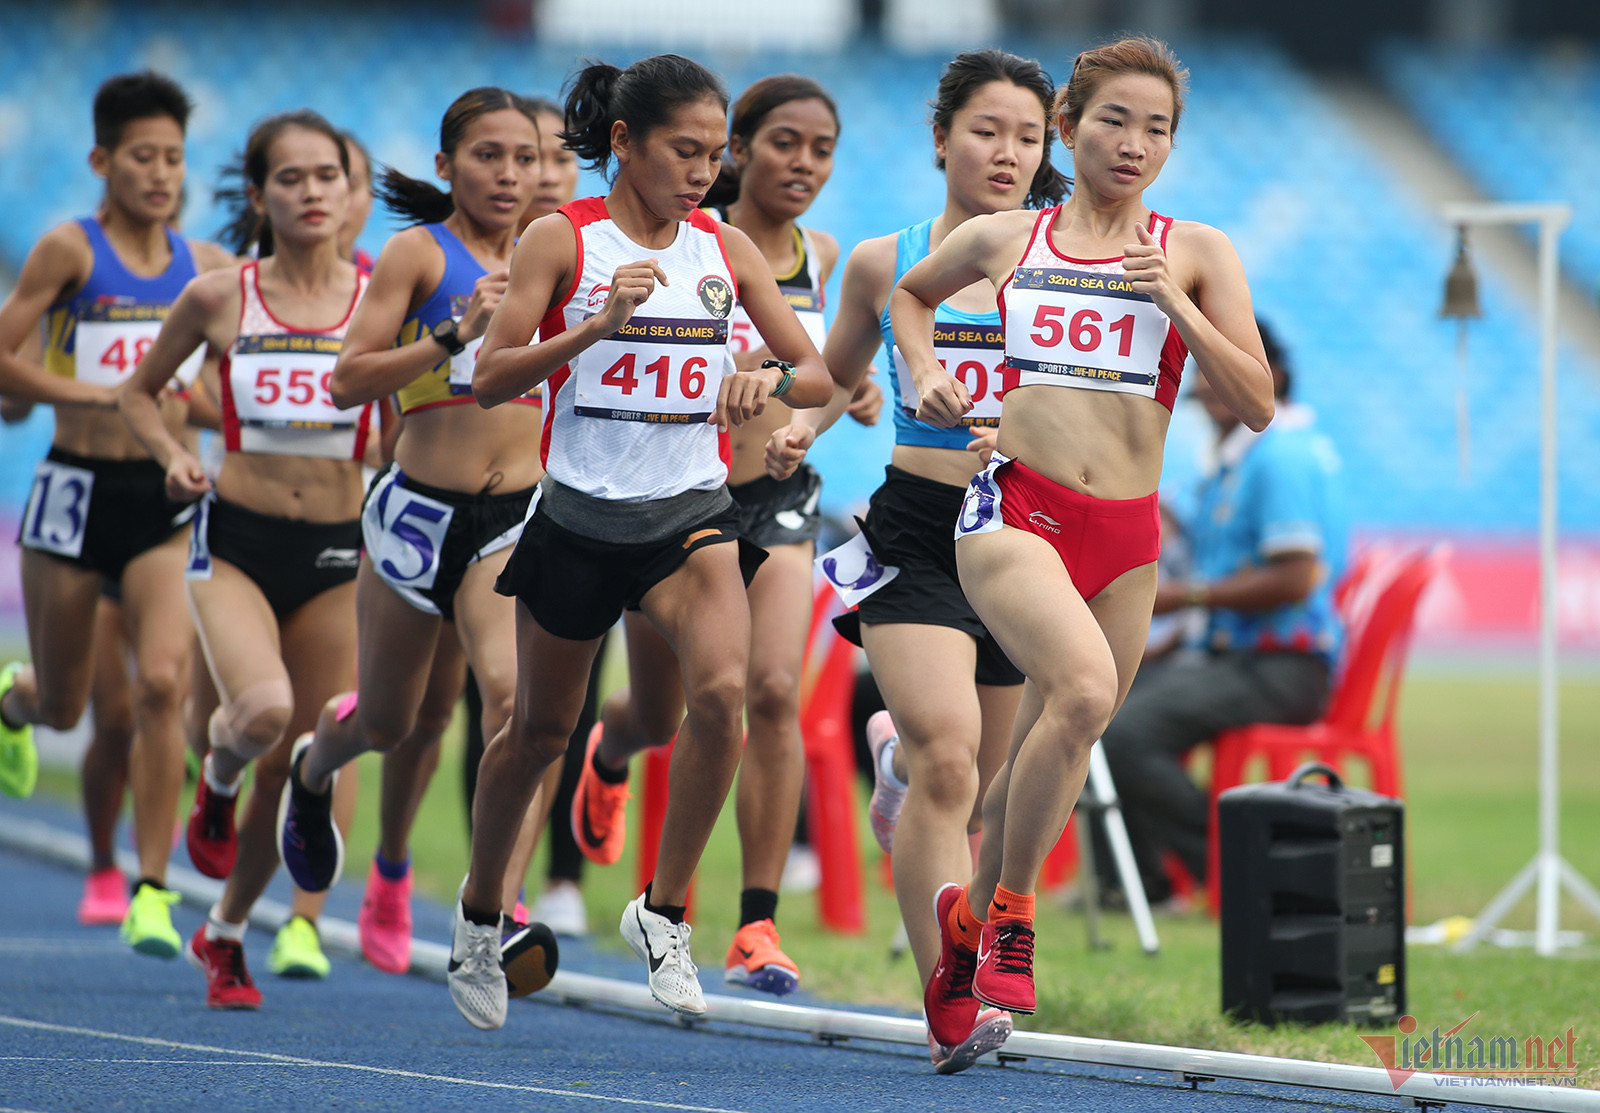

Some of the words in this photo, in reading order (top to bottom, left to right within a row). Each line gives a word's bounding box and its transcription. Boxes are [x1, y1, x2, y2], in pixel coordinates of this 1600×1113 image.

[1047, 274, 1078, 288] 32nd
[1079, 277, 1105, 290] SEA
[1107, 280, 1133, 292] GAM
[617, 324, 647, 336] 32nd
[649, 325, 674, 337] SEA
[675, 326, 715, 338] GAMES
[934, 330, 956, 342] 2nd
[958, 331, 983, 342] SEA
[985, 332, 1004, 344] GA
[1030, 304, 1136, 357] 561
[601, 352, 708, 400] 416
[1037, 362, 1069, 374] SPORTS
[1087, 368, 1097, 378] IN
[1097, 369, 1122, 381] PEACE
[611, 410, 642, 421] SPORTS
[643, 412, 660, 423] LIVE
[660, 413, 669, 423] IN
[669, 413, 691, 423] PEACE
[30, 470, 85, 545] 13
[1028, 517, 1061, 535] LI-NING
